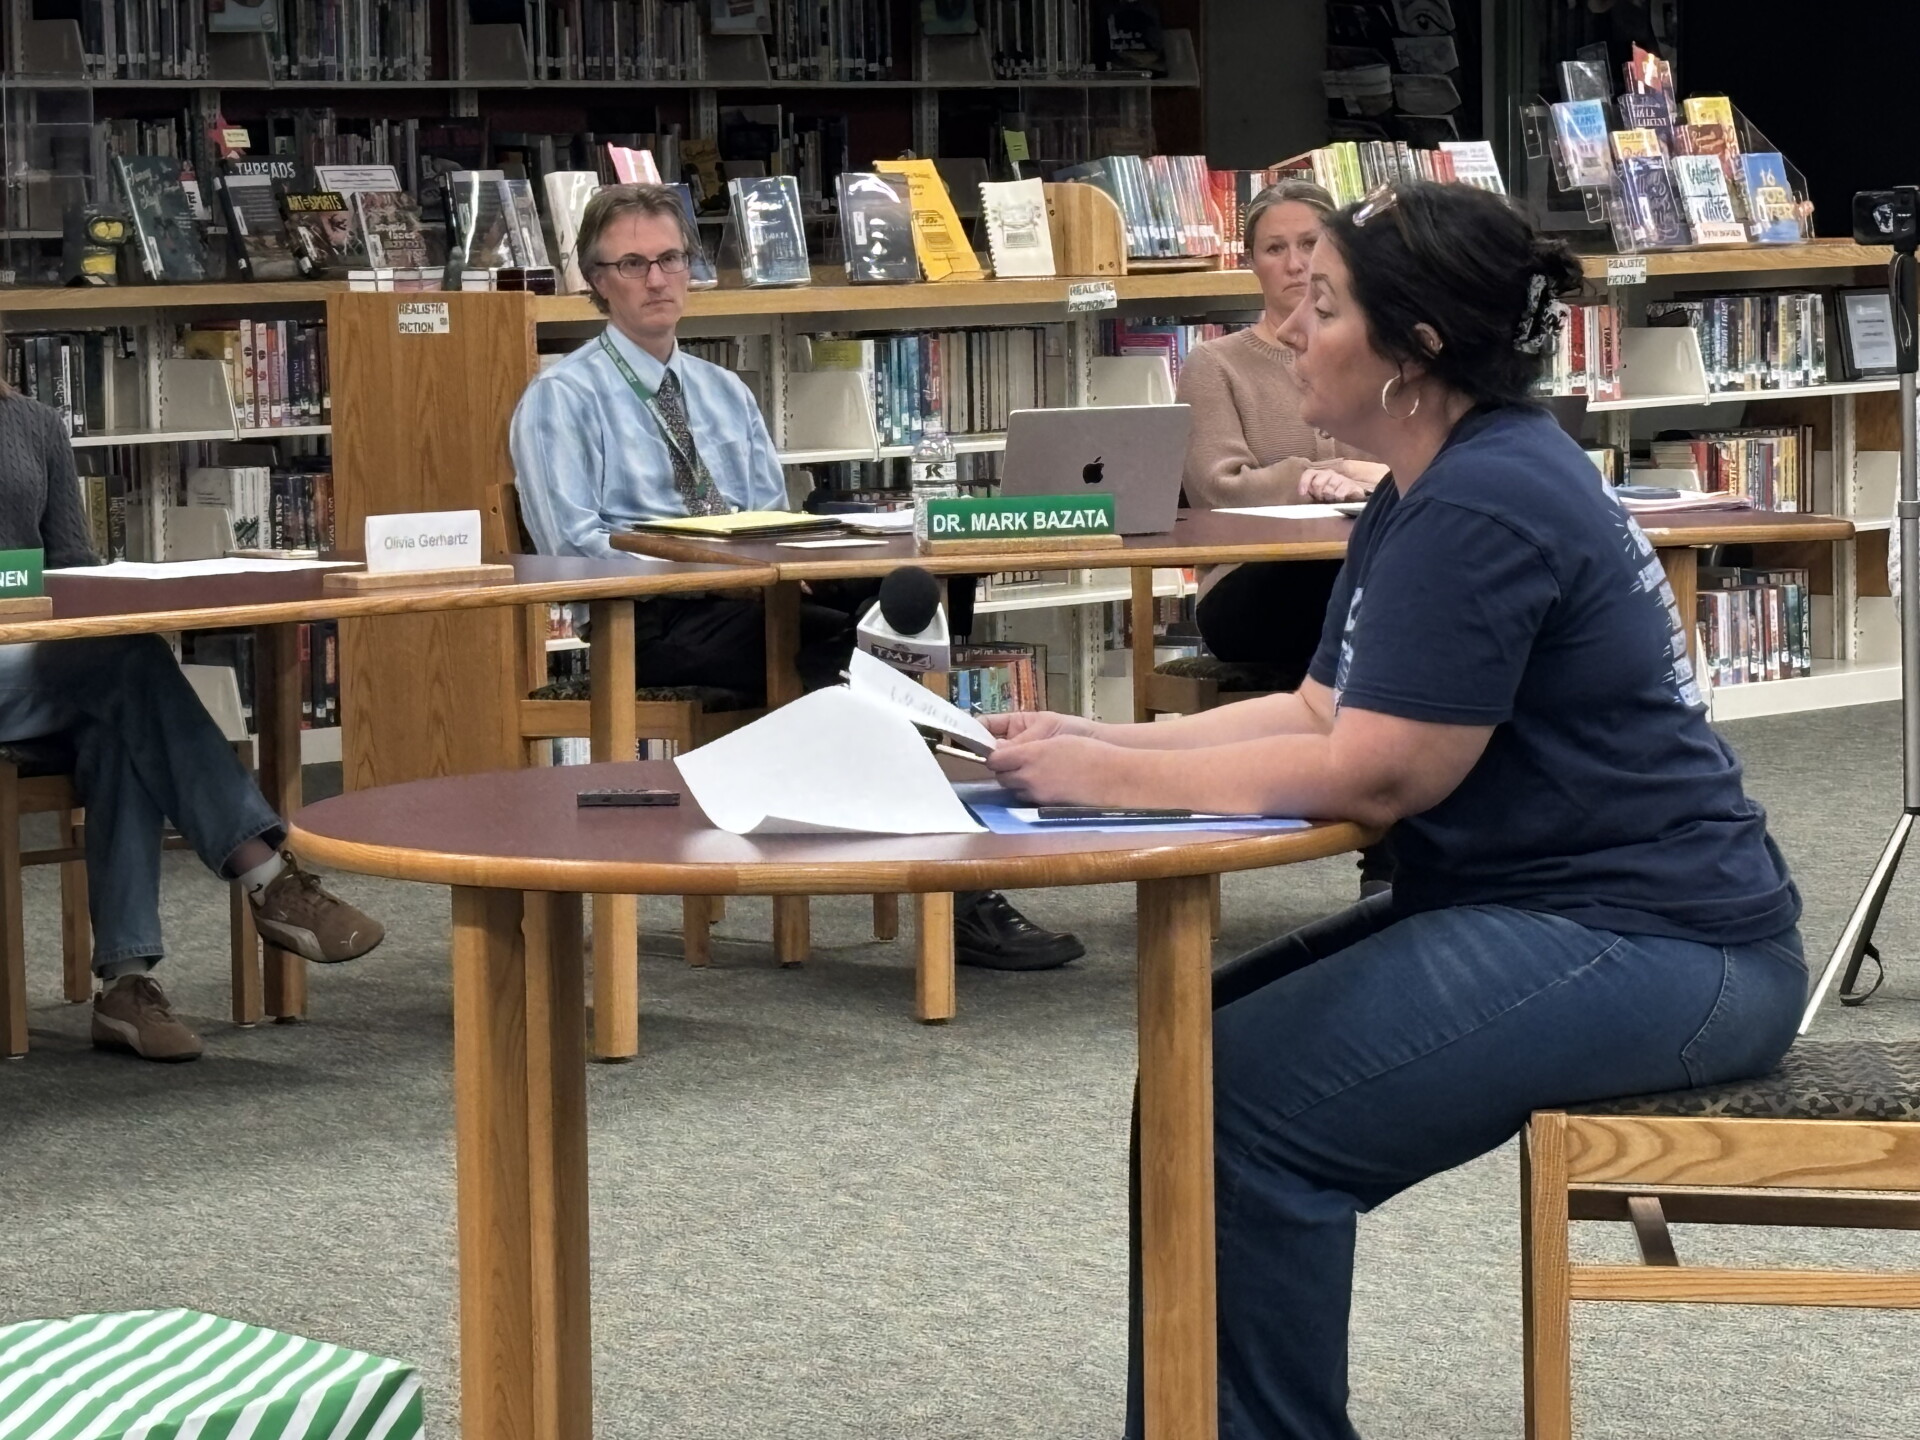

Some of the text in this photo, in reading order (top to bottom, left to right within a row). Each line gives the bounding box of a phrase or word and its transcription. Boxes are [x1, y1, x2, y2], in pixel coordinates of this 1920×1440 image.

[1759, 167, 1776, 186] 16
[1609, 258, 1646, 269] REALISTIC
[1609, 274, 1637, 285] FICTION
[1069, 282, 1115, 297] REALISTIC
[398, 302, 445, 315] REALISTIC
[1069, 299, 1106, 312] FICTION
[398, 321, 434, 333] FICTION
[932, 508, 1110, 533] DR. MARK BAZATA
[384, 533, 469, 550] Olivia Gerhartz
